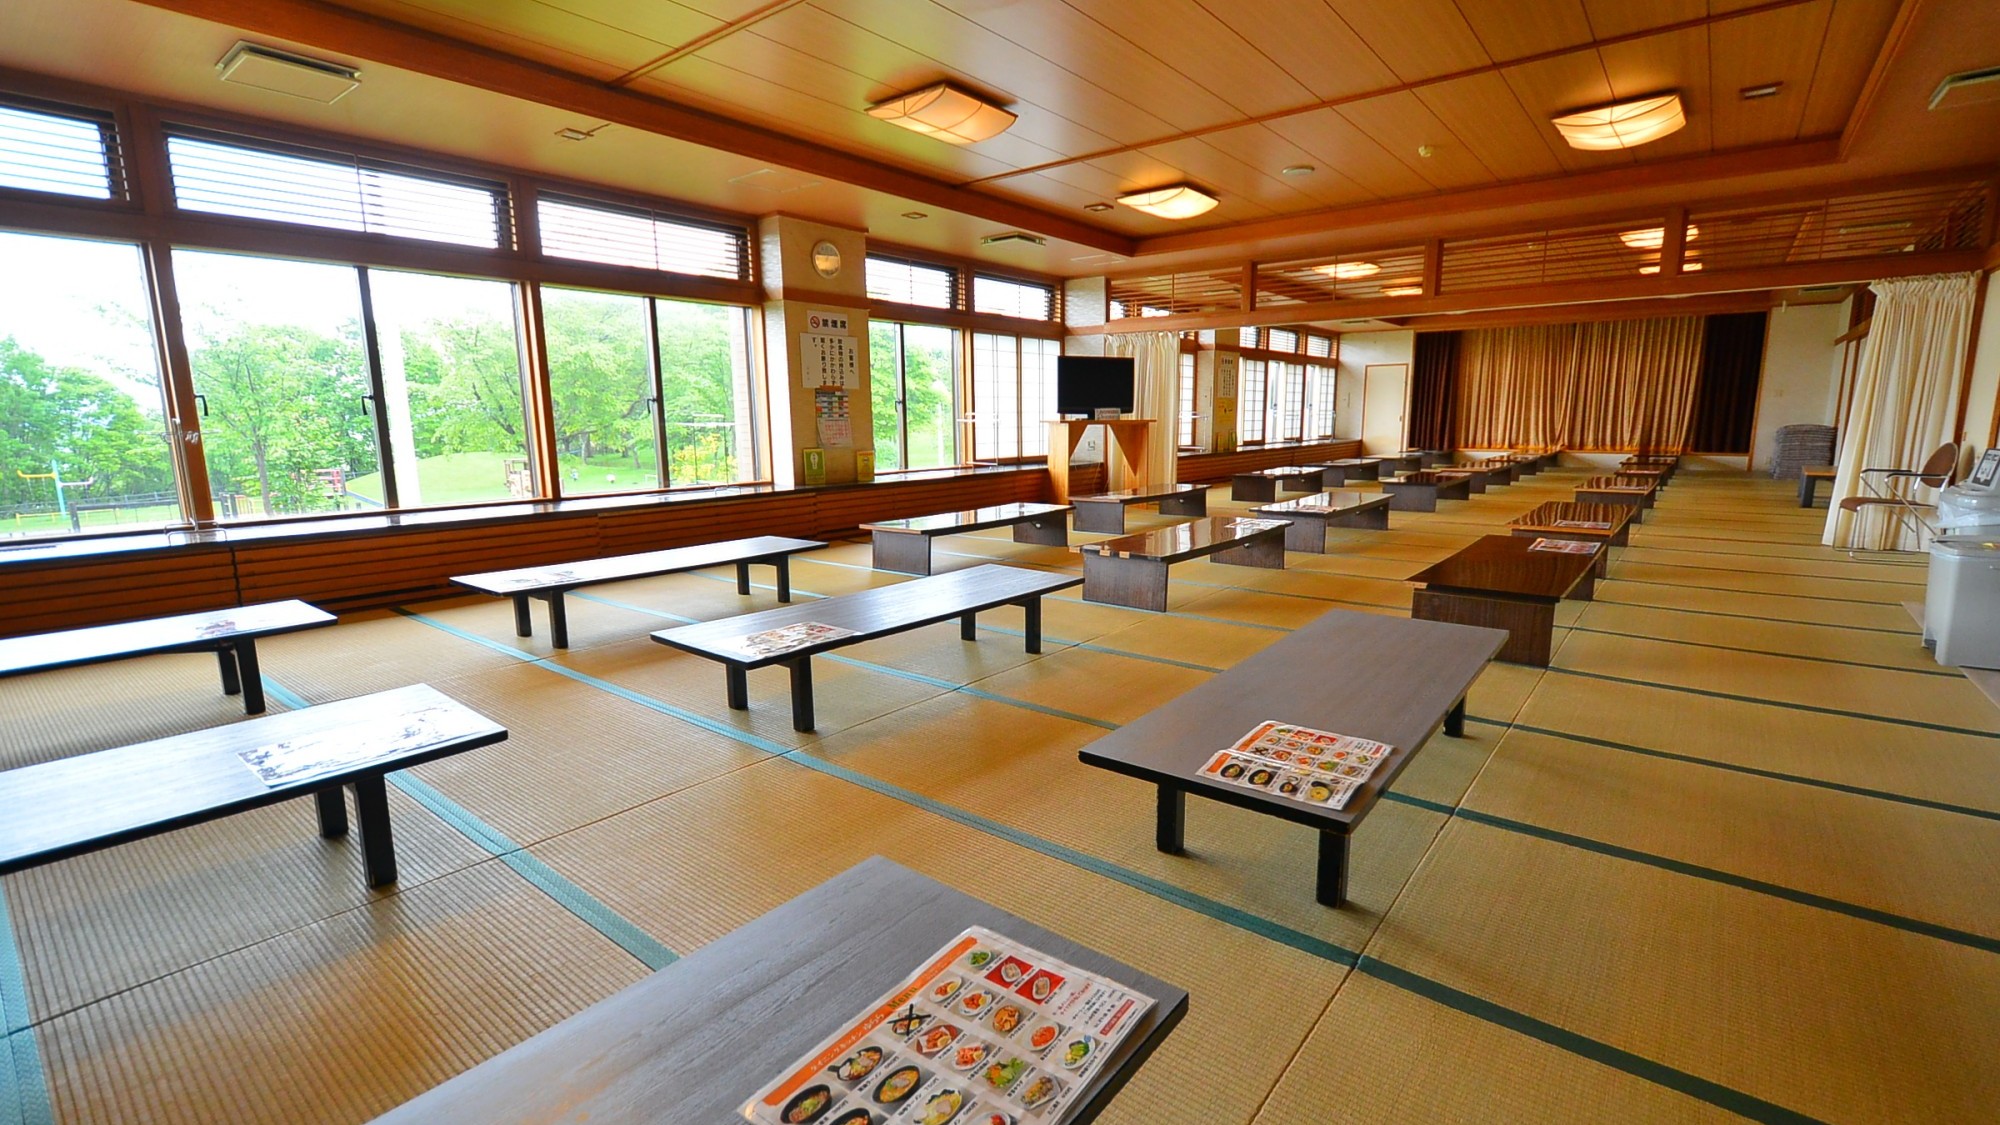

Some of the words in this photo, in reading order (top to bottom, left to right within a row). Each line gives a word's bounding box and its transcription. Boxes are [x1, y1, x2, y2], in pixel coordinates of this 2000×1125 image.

[822, 318, 847, 329] 禁煙席
[887, 987, 918, 1009] Menu
